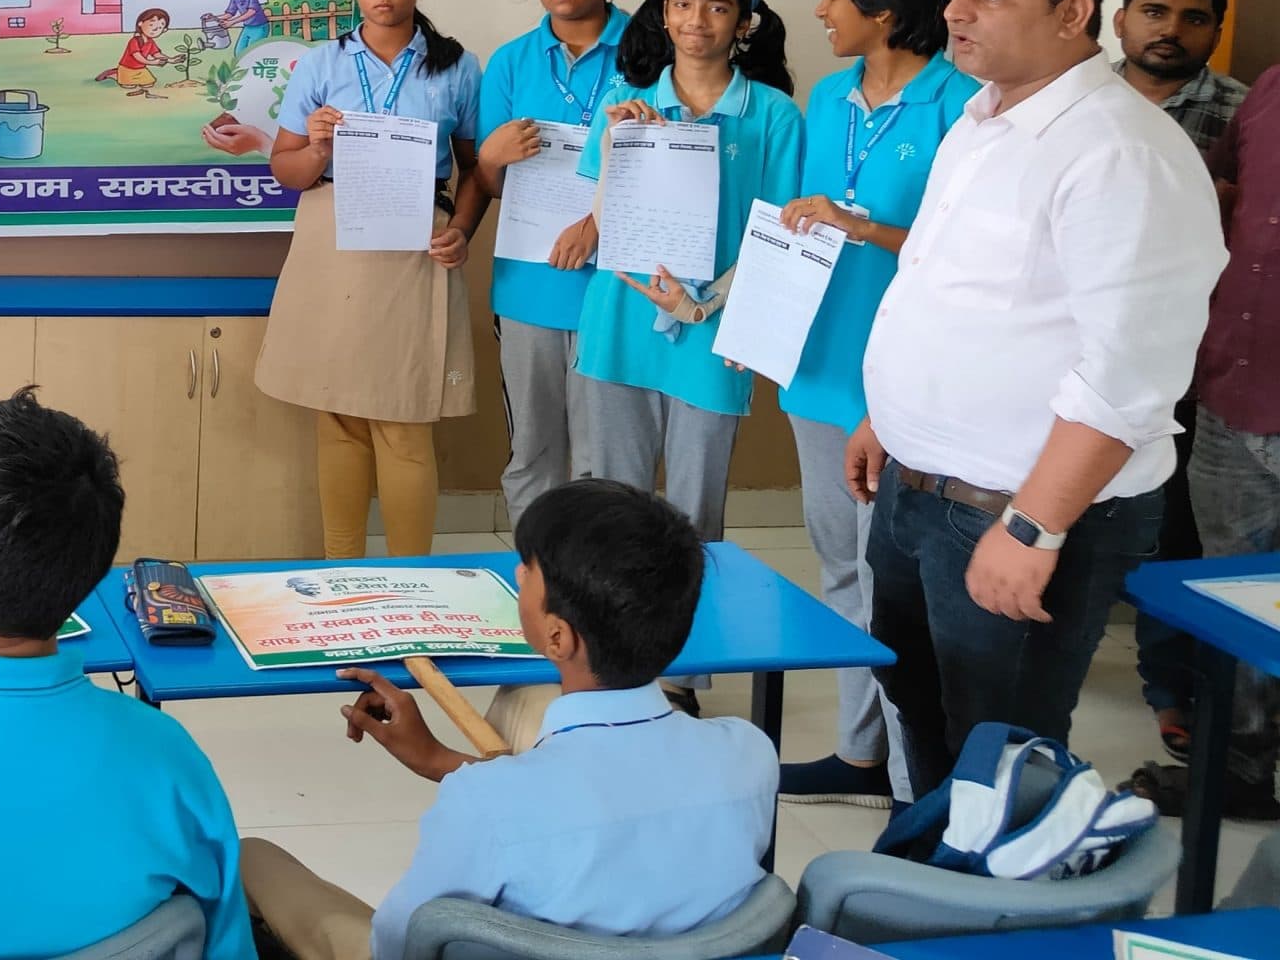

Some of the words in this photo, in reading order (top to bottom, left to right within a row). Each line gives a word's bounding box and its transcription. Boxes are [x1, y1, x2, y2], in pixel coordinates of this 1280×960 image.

[98, 168, 283, 205] समस्तीपुर
[284, 622, 315, 632] हम
[322, 615, 377, 629] सबका
[382, 613, 414, 624] एक
[420, 610, 441, 622] ही
[258, 635, 300, 647] साफ
[305, 633, 355, 646] सुथरा
[360, 628, 382, 639] हो
[387, 624, 474, 639] समस्तीपुर
